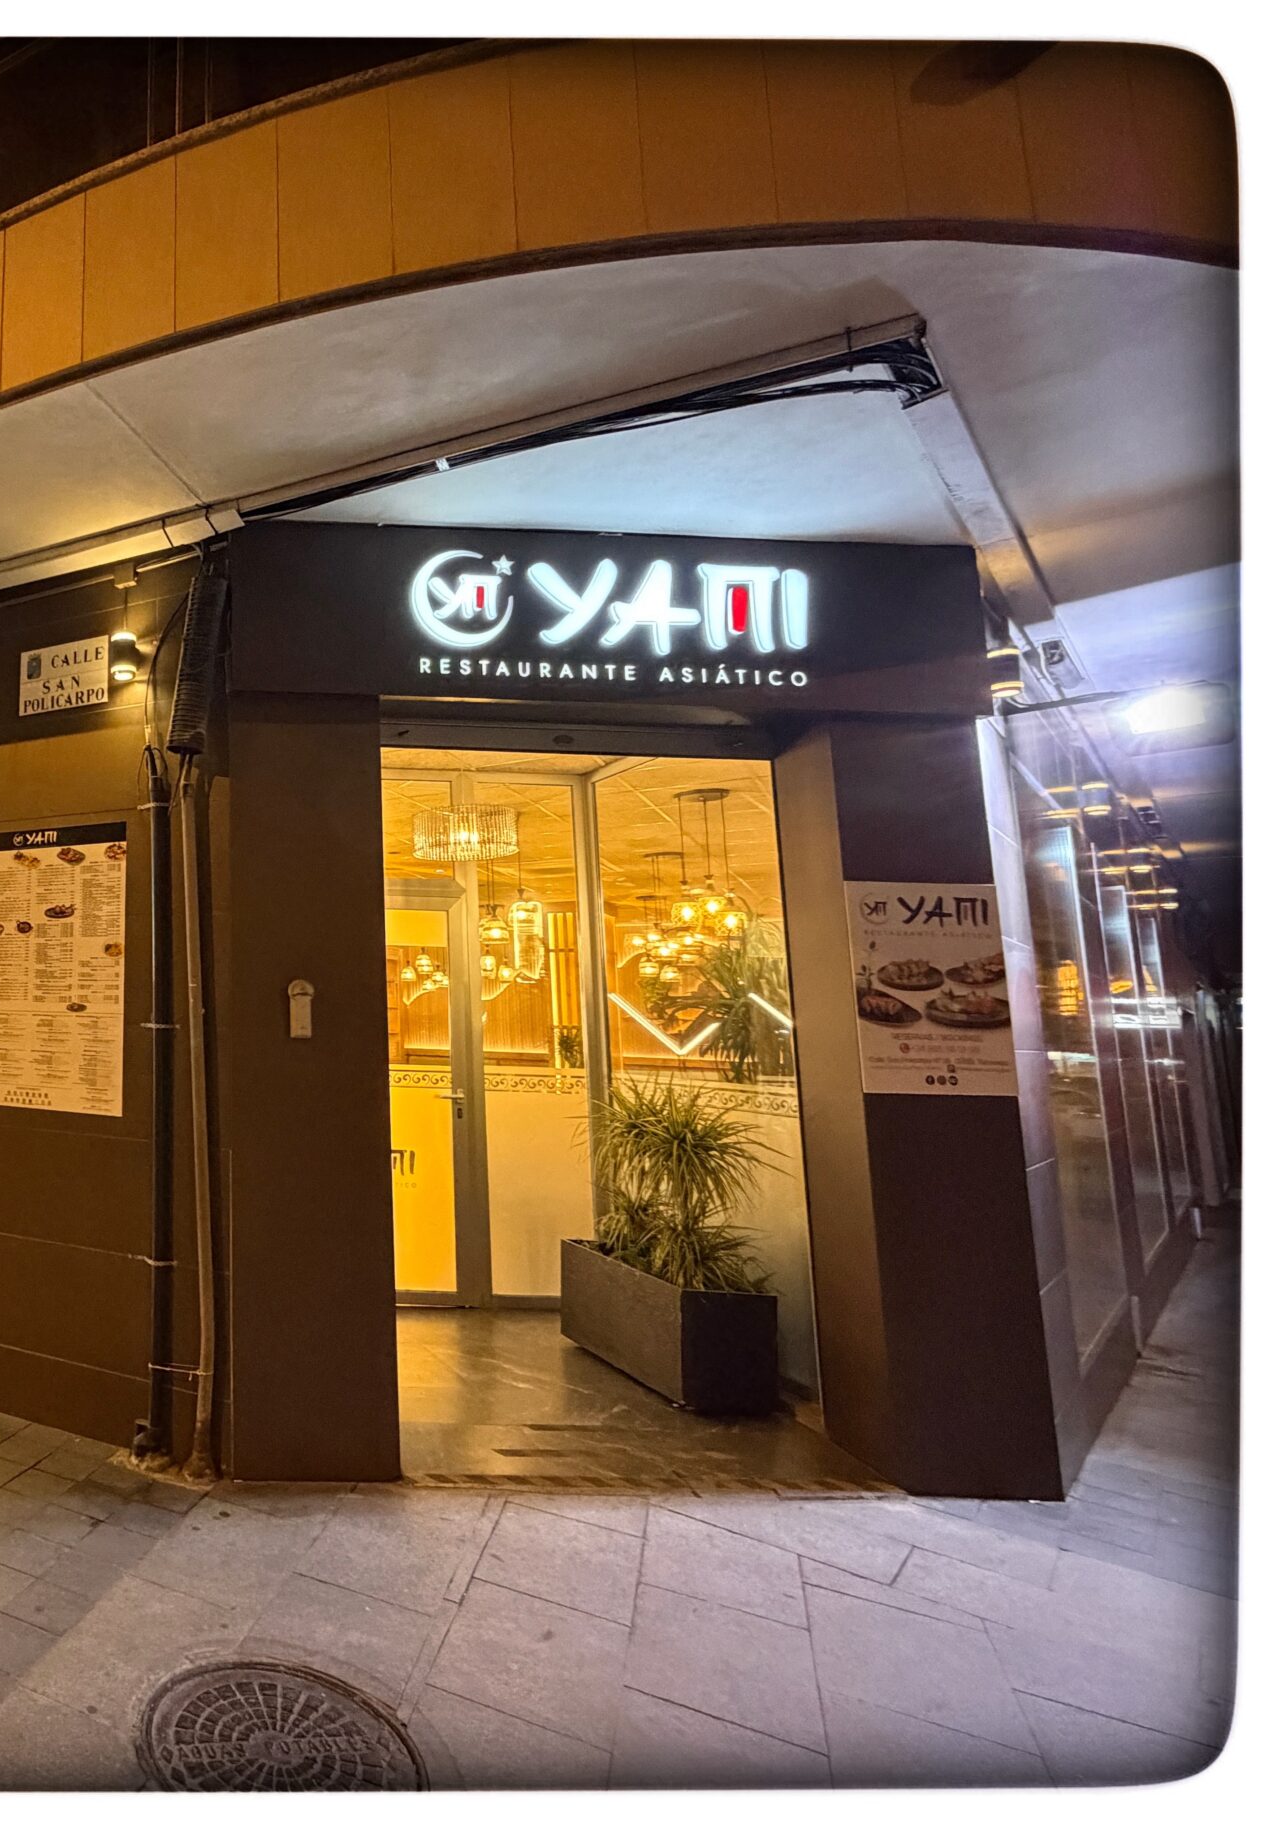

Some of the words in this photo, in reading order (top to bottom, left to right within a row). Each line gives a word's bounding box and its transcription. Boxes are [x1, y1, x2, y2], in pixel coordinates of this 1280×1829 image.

[526, 558, 810, 655] YAMI
[51, 646, 105, 669] CALLE
[42, 675, 80, 695] SAN
[419, 657, 637, 681] RESTAURANTE
[658, 664, 809, 687] ASIÁTICO
[23, 687, 105, 714] POLICARPO
[896, 895, 989, 928] YAMI
